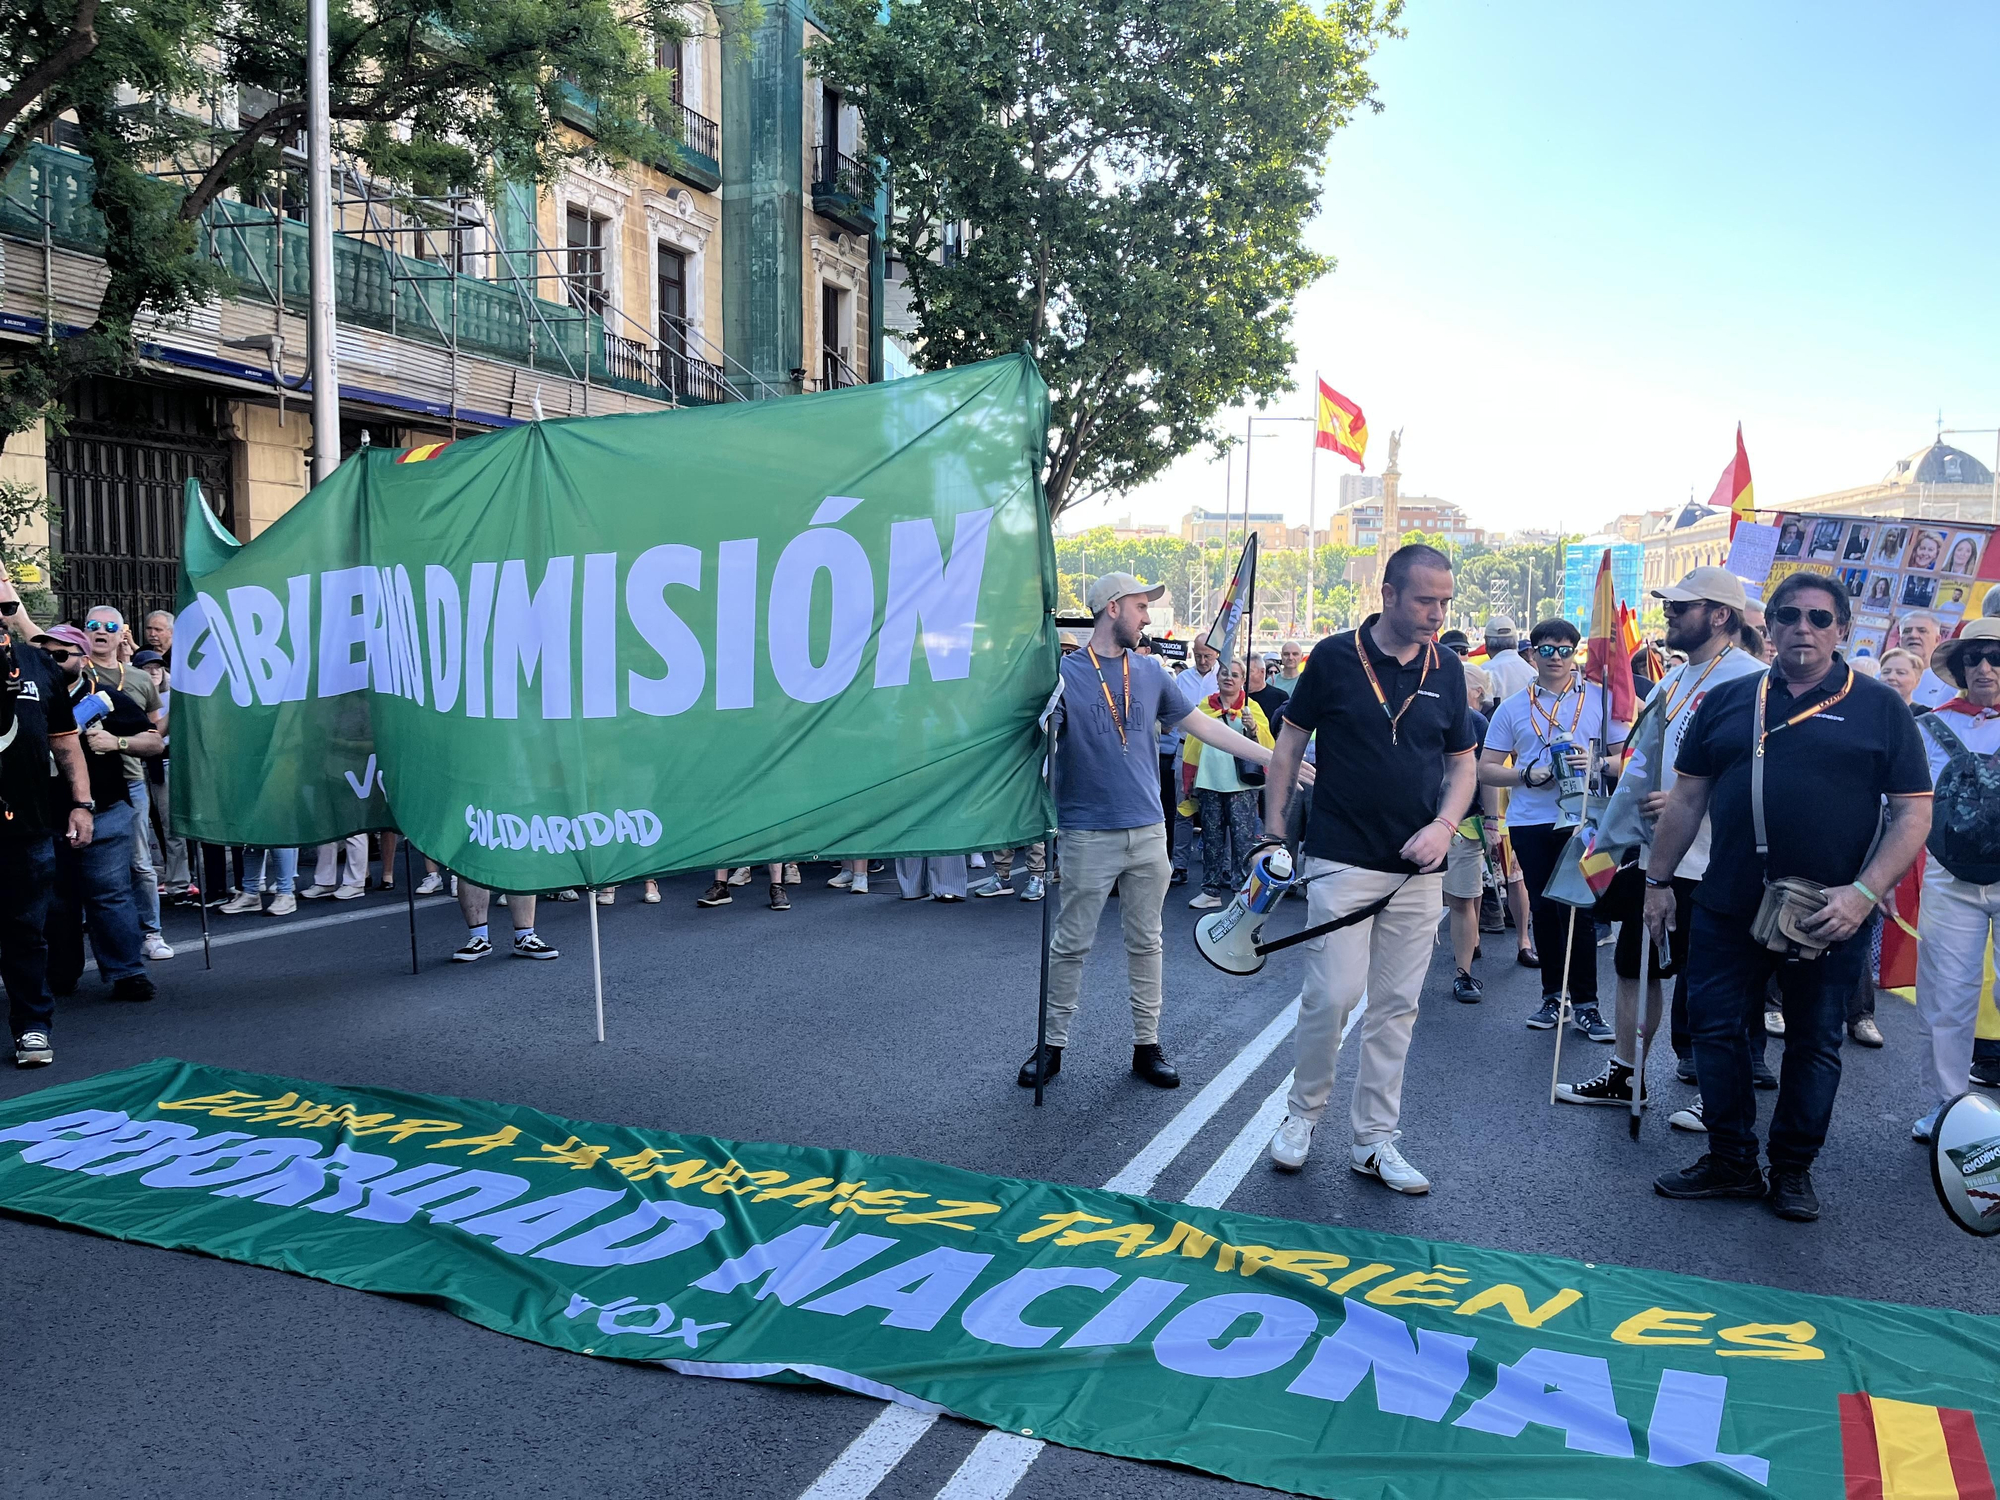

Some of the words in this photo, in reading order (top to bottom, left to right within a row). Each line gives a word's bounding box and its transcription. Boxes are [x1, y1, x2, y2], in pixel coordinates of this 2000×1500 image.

[425, 496, 994, 719] DIMISIÓN
[465, 804, 663, 854] SOLIDARIDAD
[1962, 1146, 2000, 1174] DARIDAD
[564, 1293, 731, 1348] VOX
[1017, 1210, 1583, 1328] TAMBIÉN
[1611, 1306, 1825, 1360] ES
[689, 1221, 1769, 1486] NACIONAL
